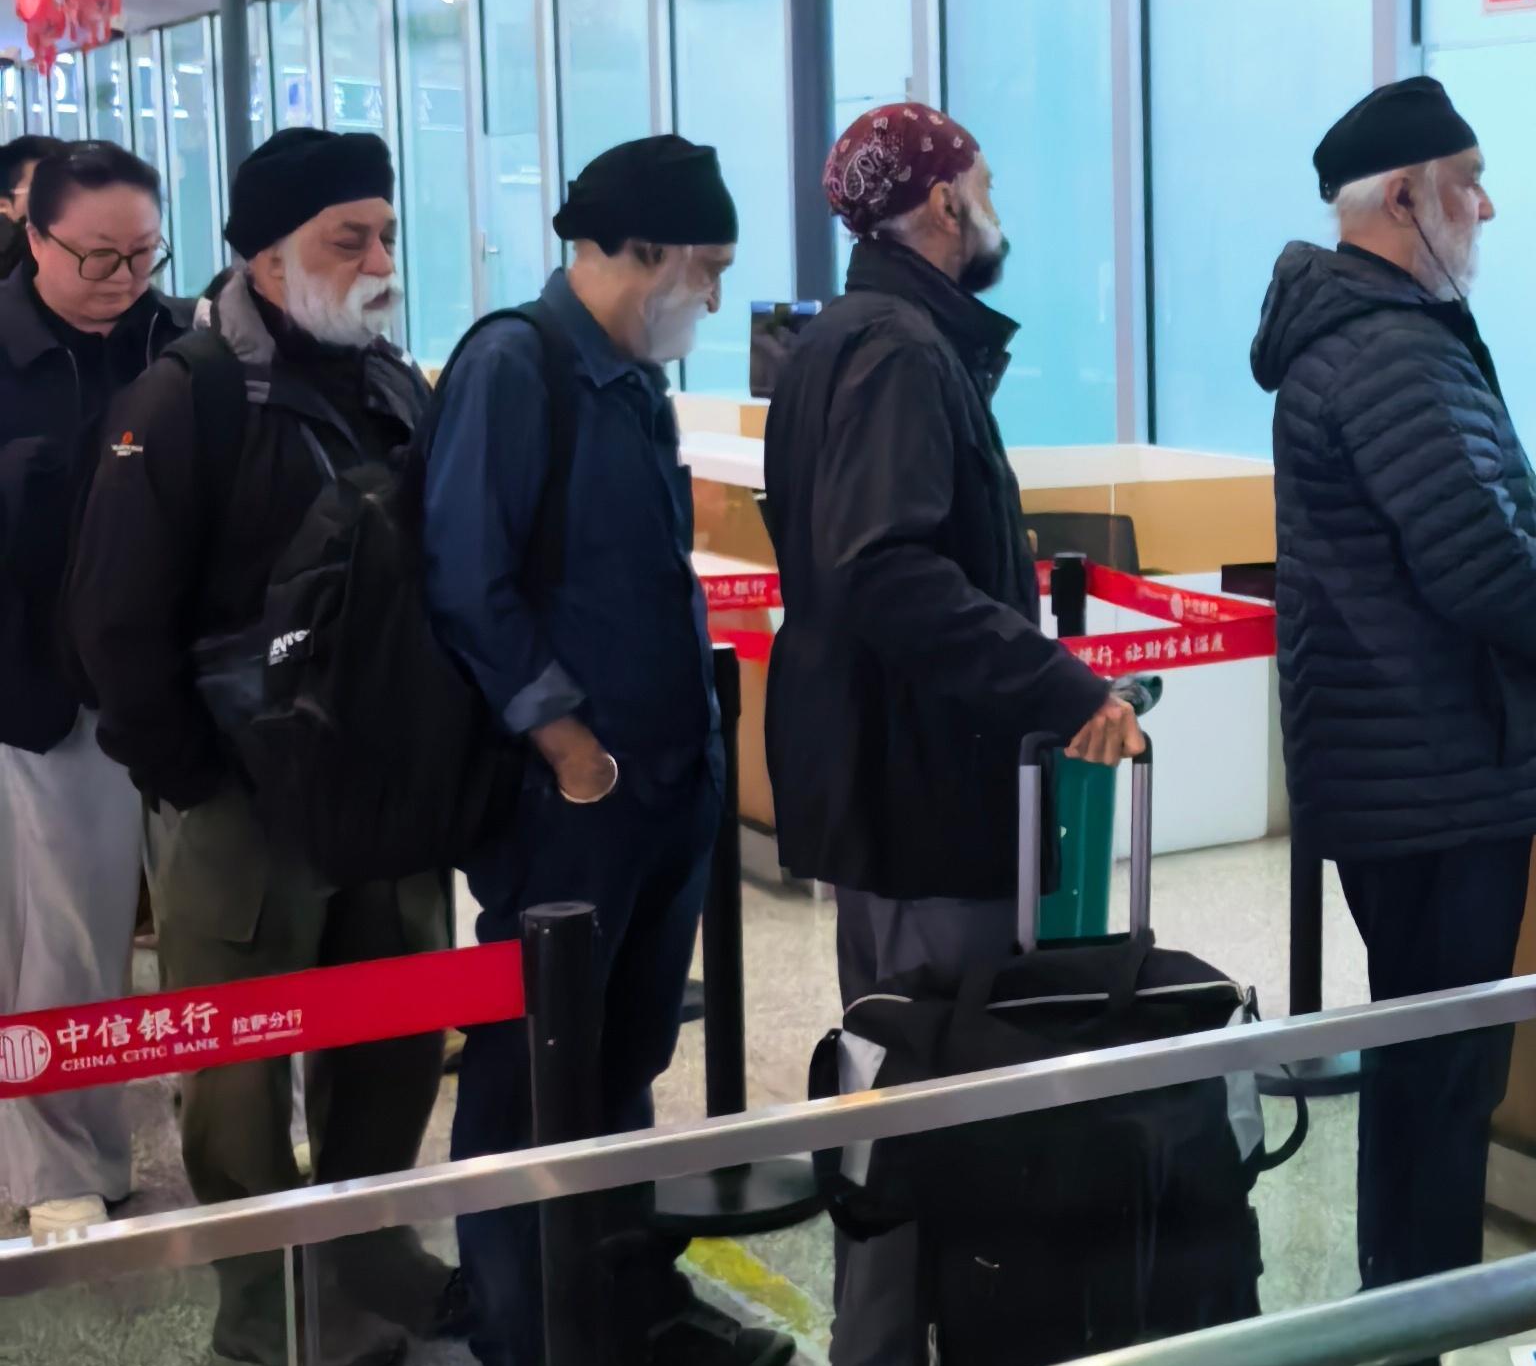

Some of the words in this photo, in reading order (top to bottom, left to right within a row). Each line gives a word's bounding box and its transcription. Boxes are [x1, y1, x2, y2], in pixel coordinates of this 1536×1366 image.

[57, 1002, 219, 1053] 中信银行
[61, 1053, 117, 1071] CHINA
[122, 1045, 168, 1063] CITIC
[173, 1037, 220, 1055] BANK
